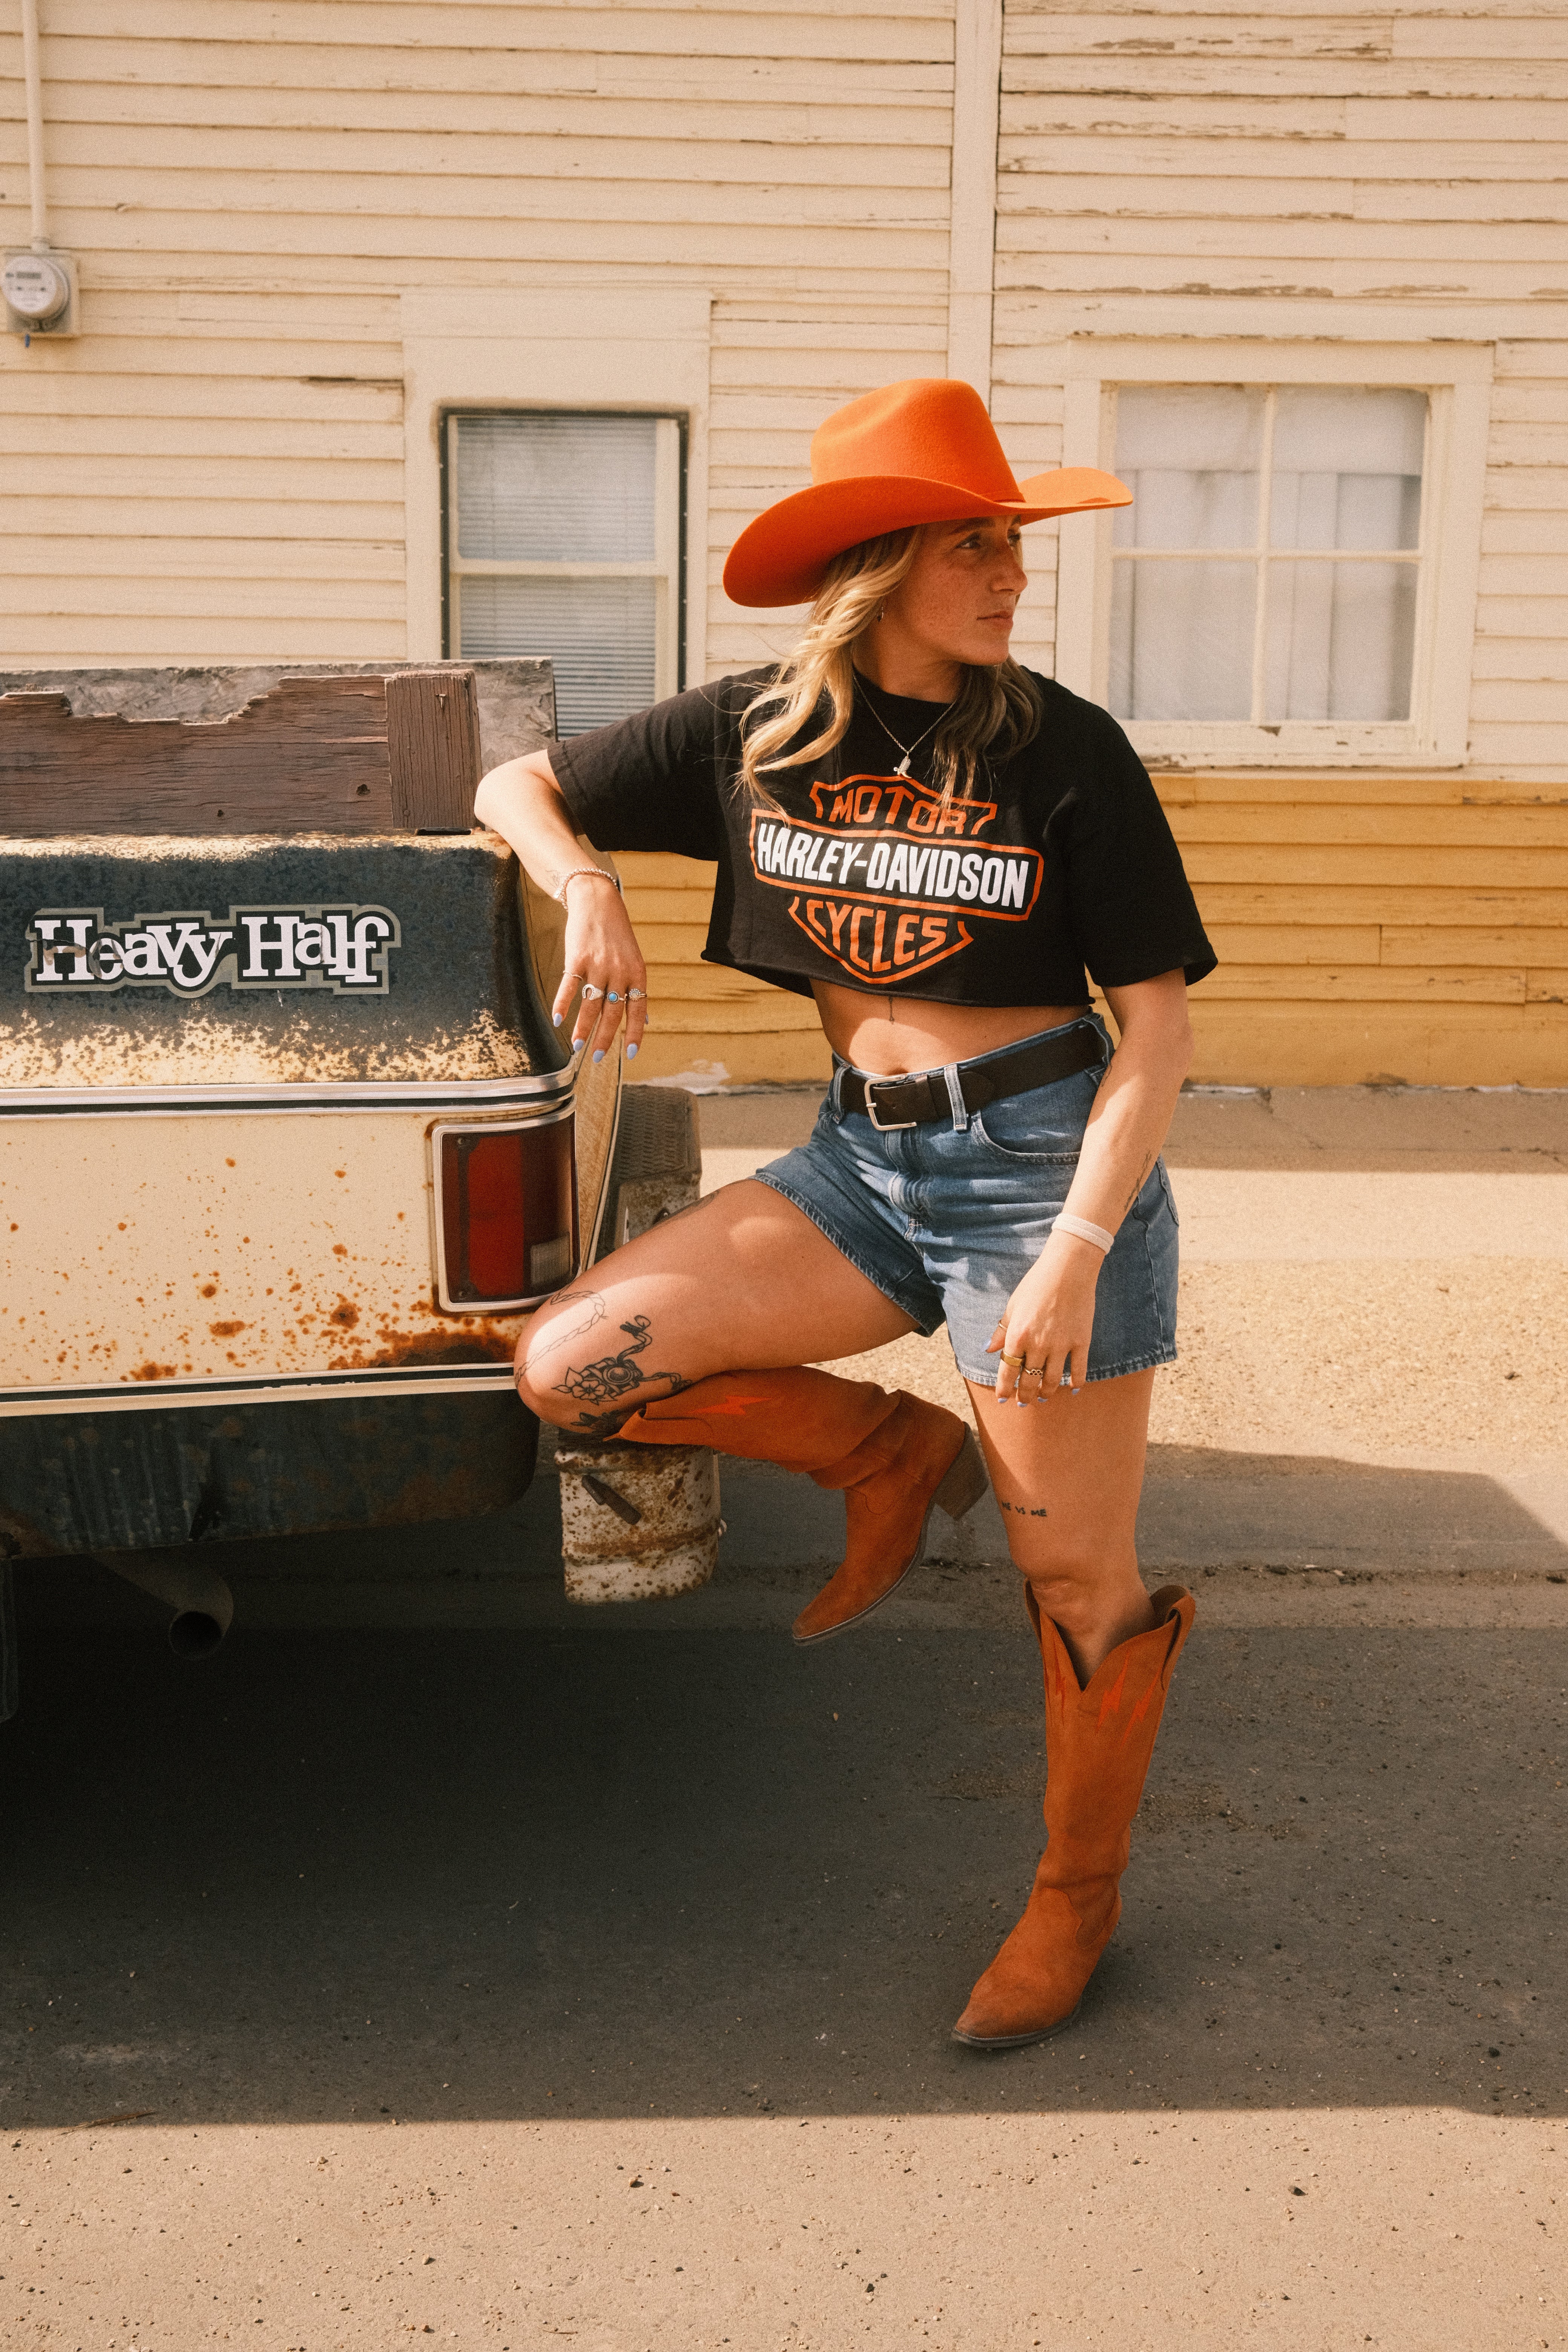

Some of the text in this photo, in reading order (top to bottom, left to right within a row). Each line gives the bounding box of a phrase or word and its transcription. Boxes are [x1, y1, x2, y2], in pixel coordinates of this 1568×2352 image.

[828, 786, 967, 835] MOTOR
[757, 823, 1029, 908] HARLEY-DAVIDSON
[35, 916, 389, 987] Heavy Half
[806, 899, 948, 972] CYCLES
